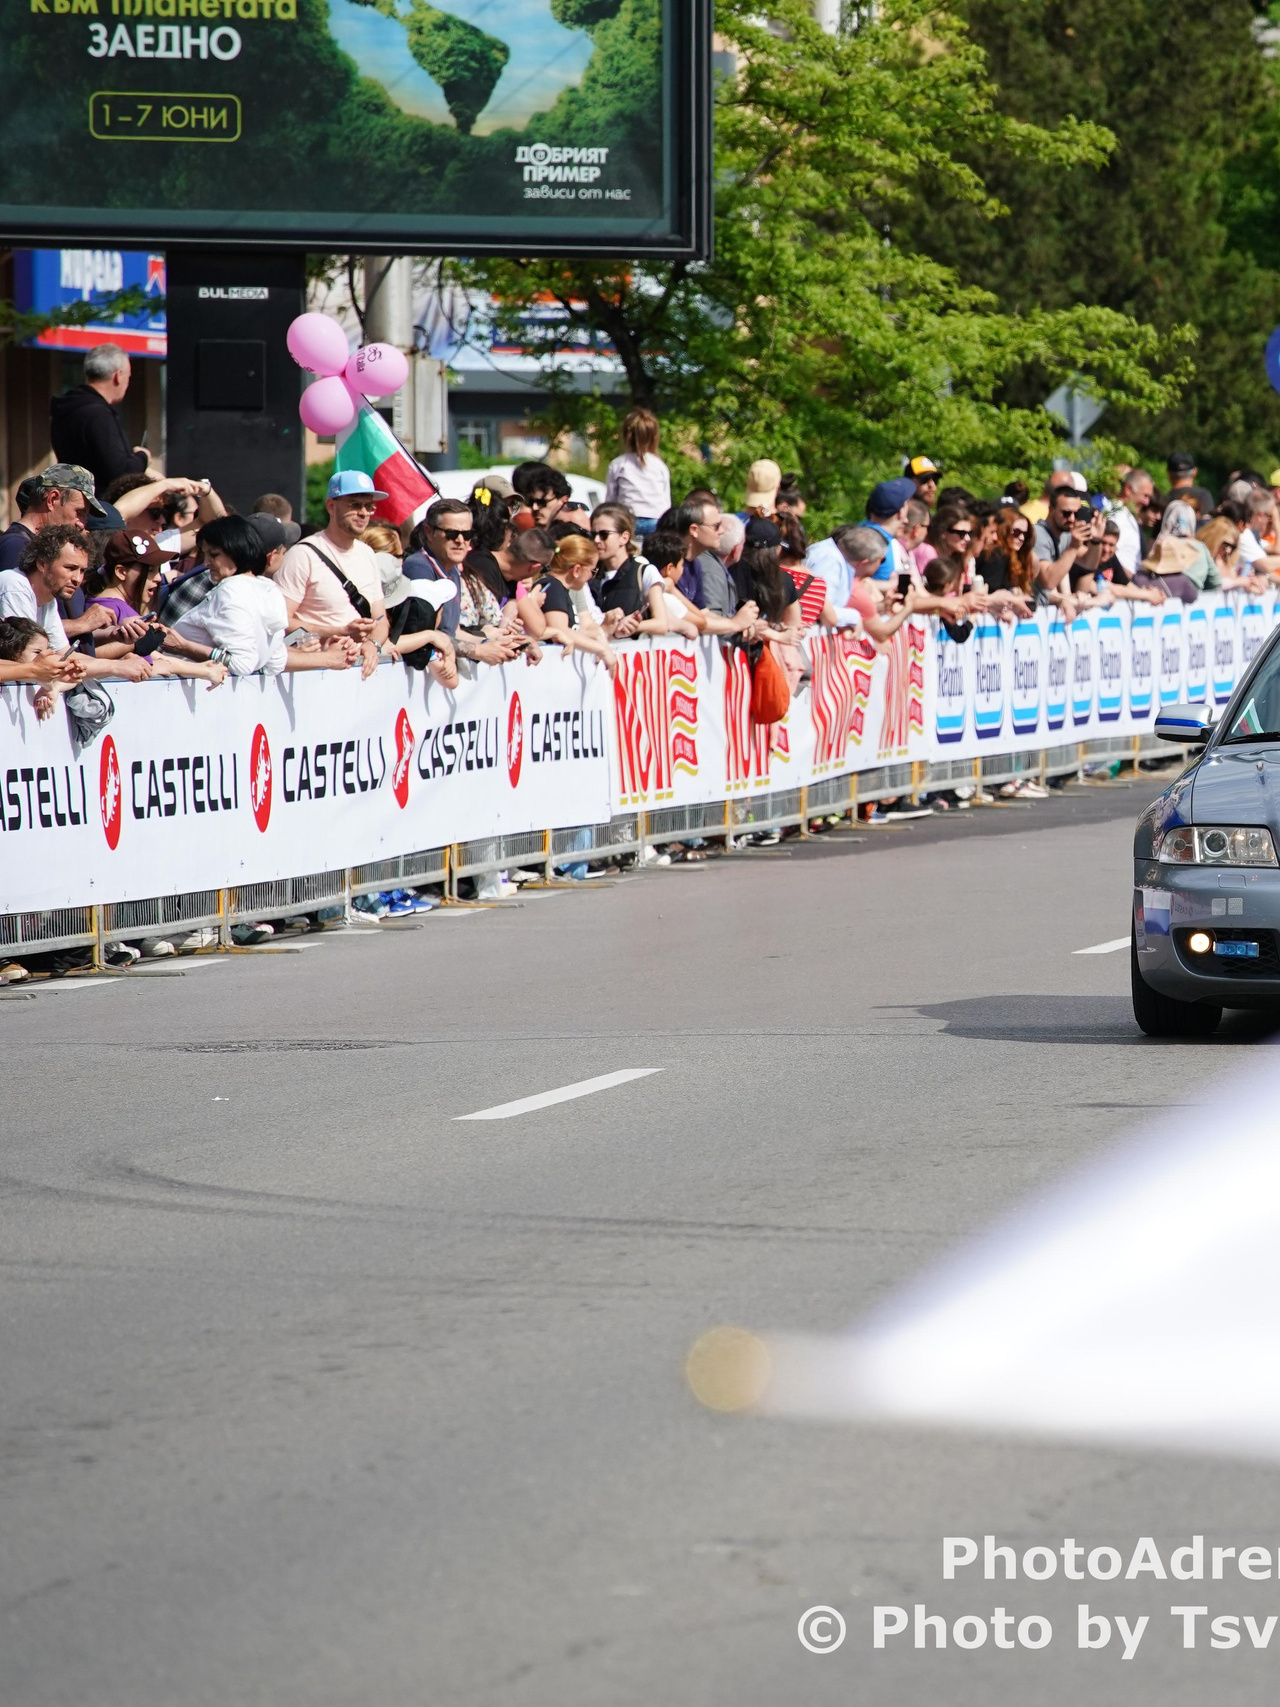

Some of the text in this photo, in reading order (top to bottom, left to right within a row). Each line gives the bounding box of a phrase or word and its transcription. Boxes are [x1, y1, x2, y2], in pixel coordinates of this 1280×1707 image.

[111, 0, 299, 20] планетата
[87, 23, 242, 61] ЗАЕДНО
[162, 105, 228, 130] ЮНИ
[515, 143, 609, 166] ДОБРИЯТ
[523, 165, 601, 183] ПРИМЕР
[523, 184, 631, 200] зависи от нас
[976, 650, 1001, 703] Regina
[1014, 648, 1039, 699] Regina
[1099, 640, 1121, 688] Regina
[418, 717, 498, 780] CASTELLI
[530, 709, 604, 763] CASTELLI
[131, 753, 238, 820] CASTELLI
[283, 736, 385, 802] CASTELLI
[0, 765, 88, 831] ASTELLI
